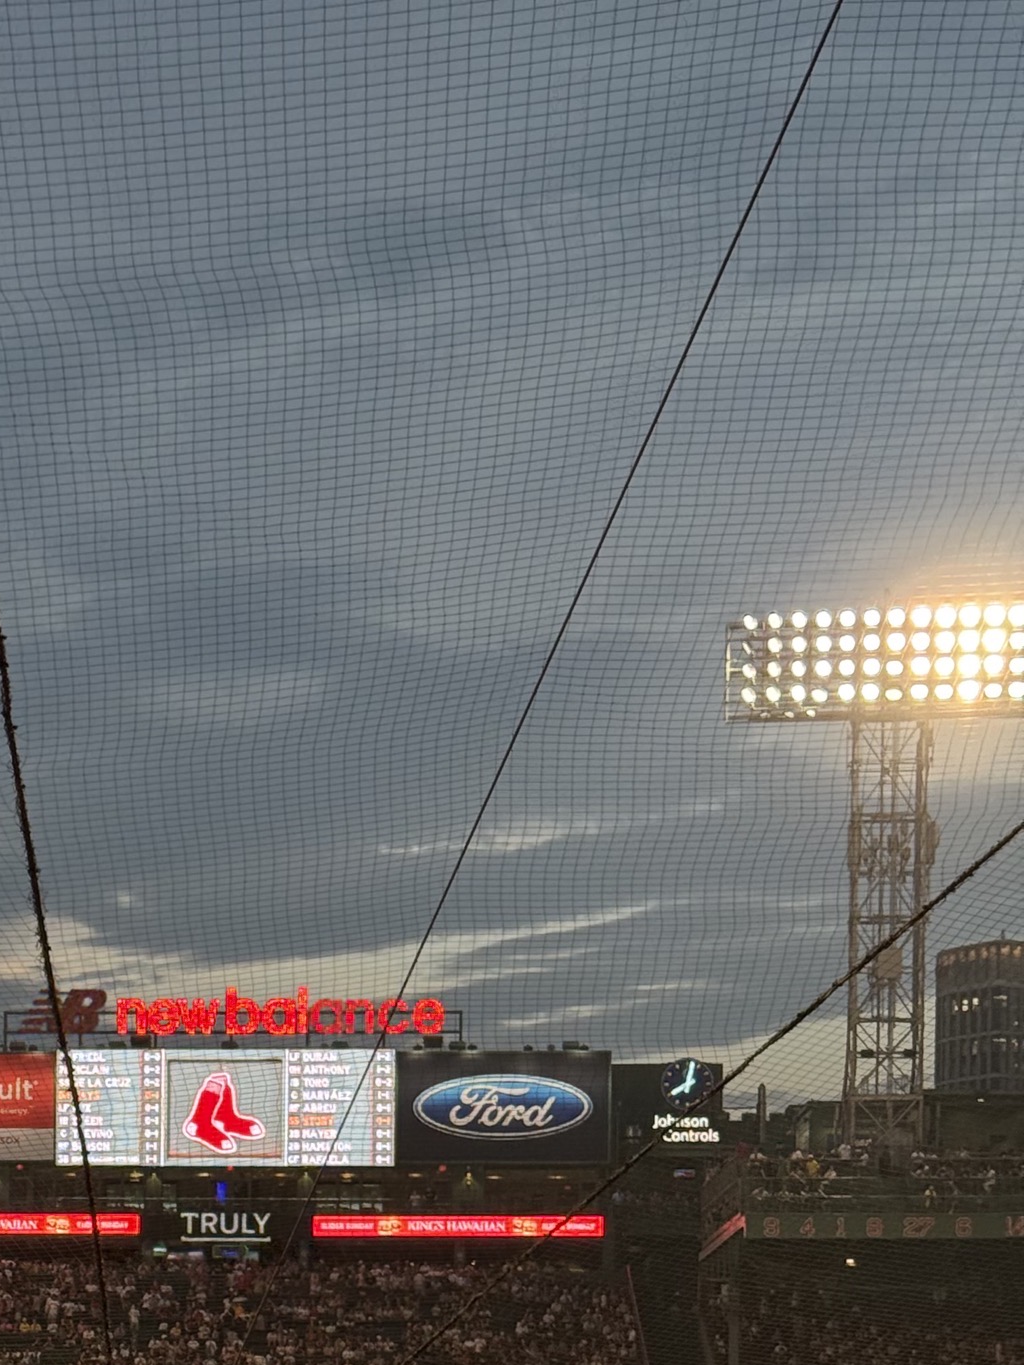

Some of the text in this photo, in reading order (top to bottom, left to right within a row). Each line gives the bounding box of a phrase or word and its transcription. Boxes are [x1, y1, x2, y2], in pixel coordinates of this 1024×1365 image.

[115, 985, 445, 1036] new balance
[303, 1065, 351, 1075] ANTHONY
[449, 1086, 557, 1129] Ford
[662, 1128, 720, 1143] Controls
[180, 1212, 271, 1234] TRULY
[446, 1220, 506, 1233] HAWAIIAN
[800, 1216, 816, 1238] 4
[836, 1216, 846, 1238] 1
[903, 1216, 934, 1238] 27
